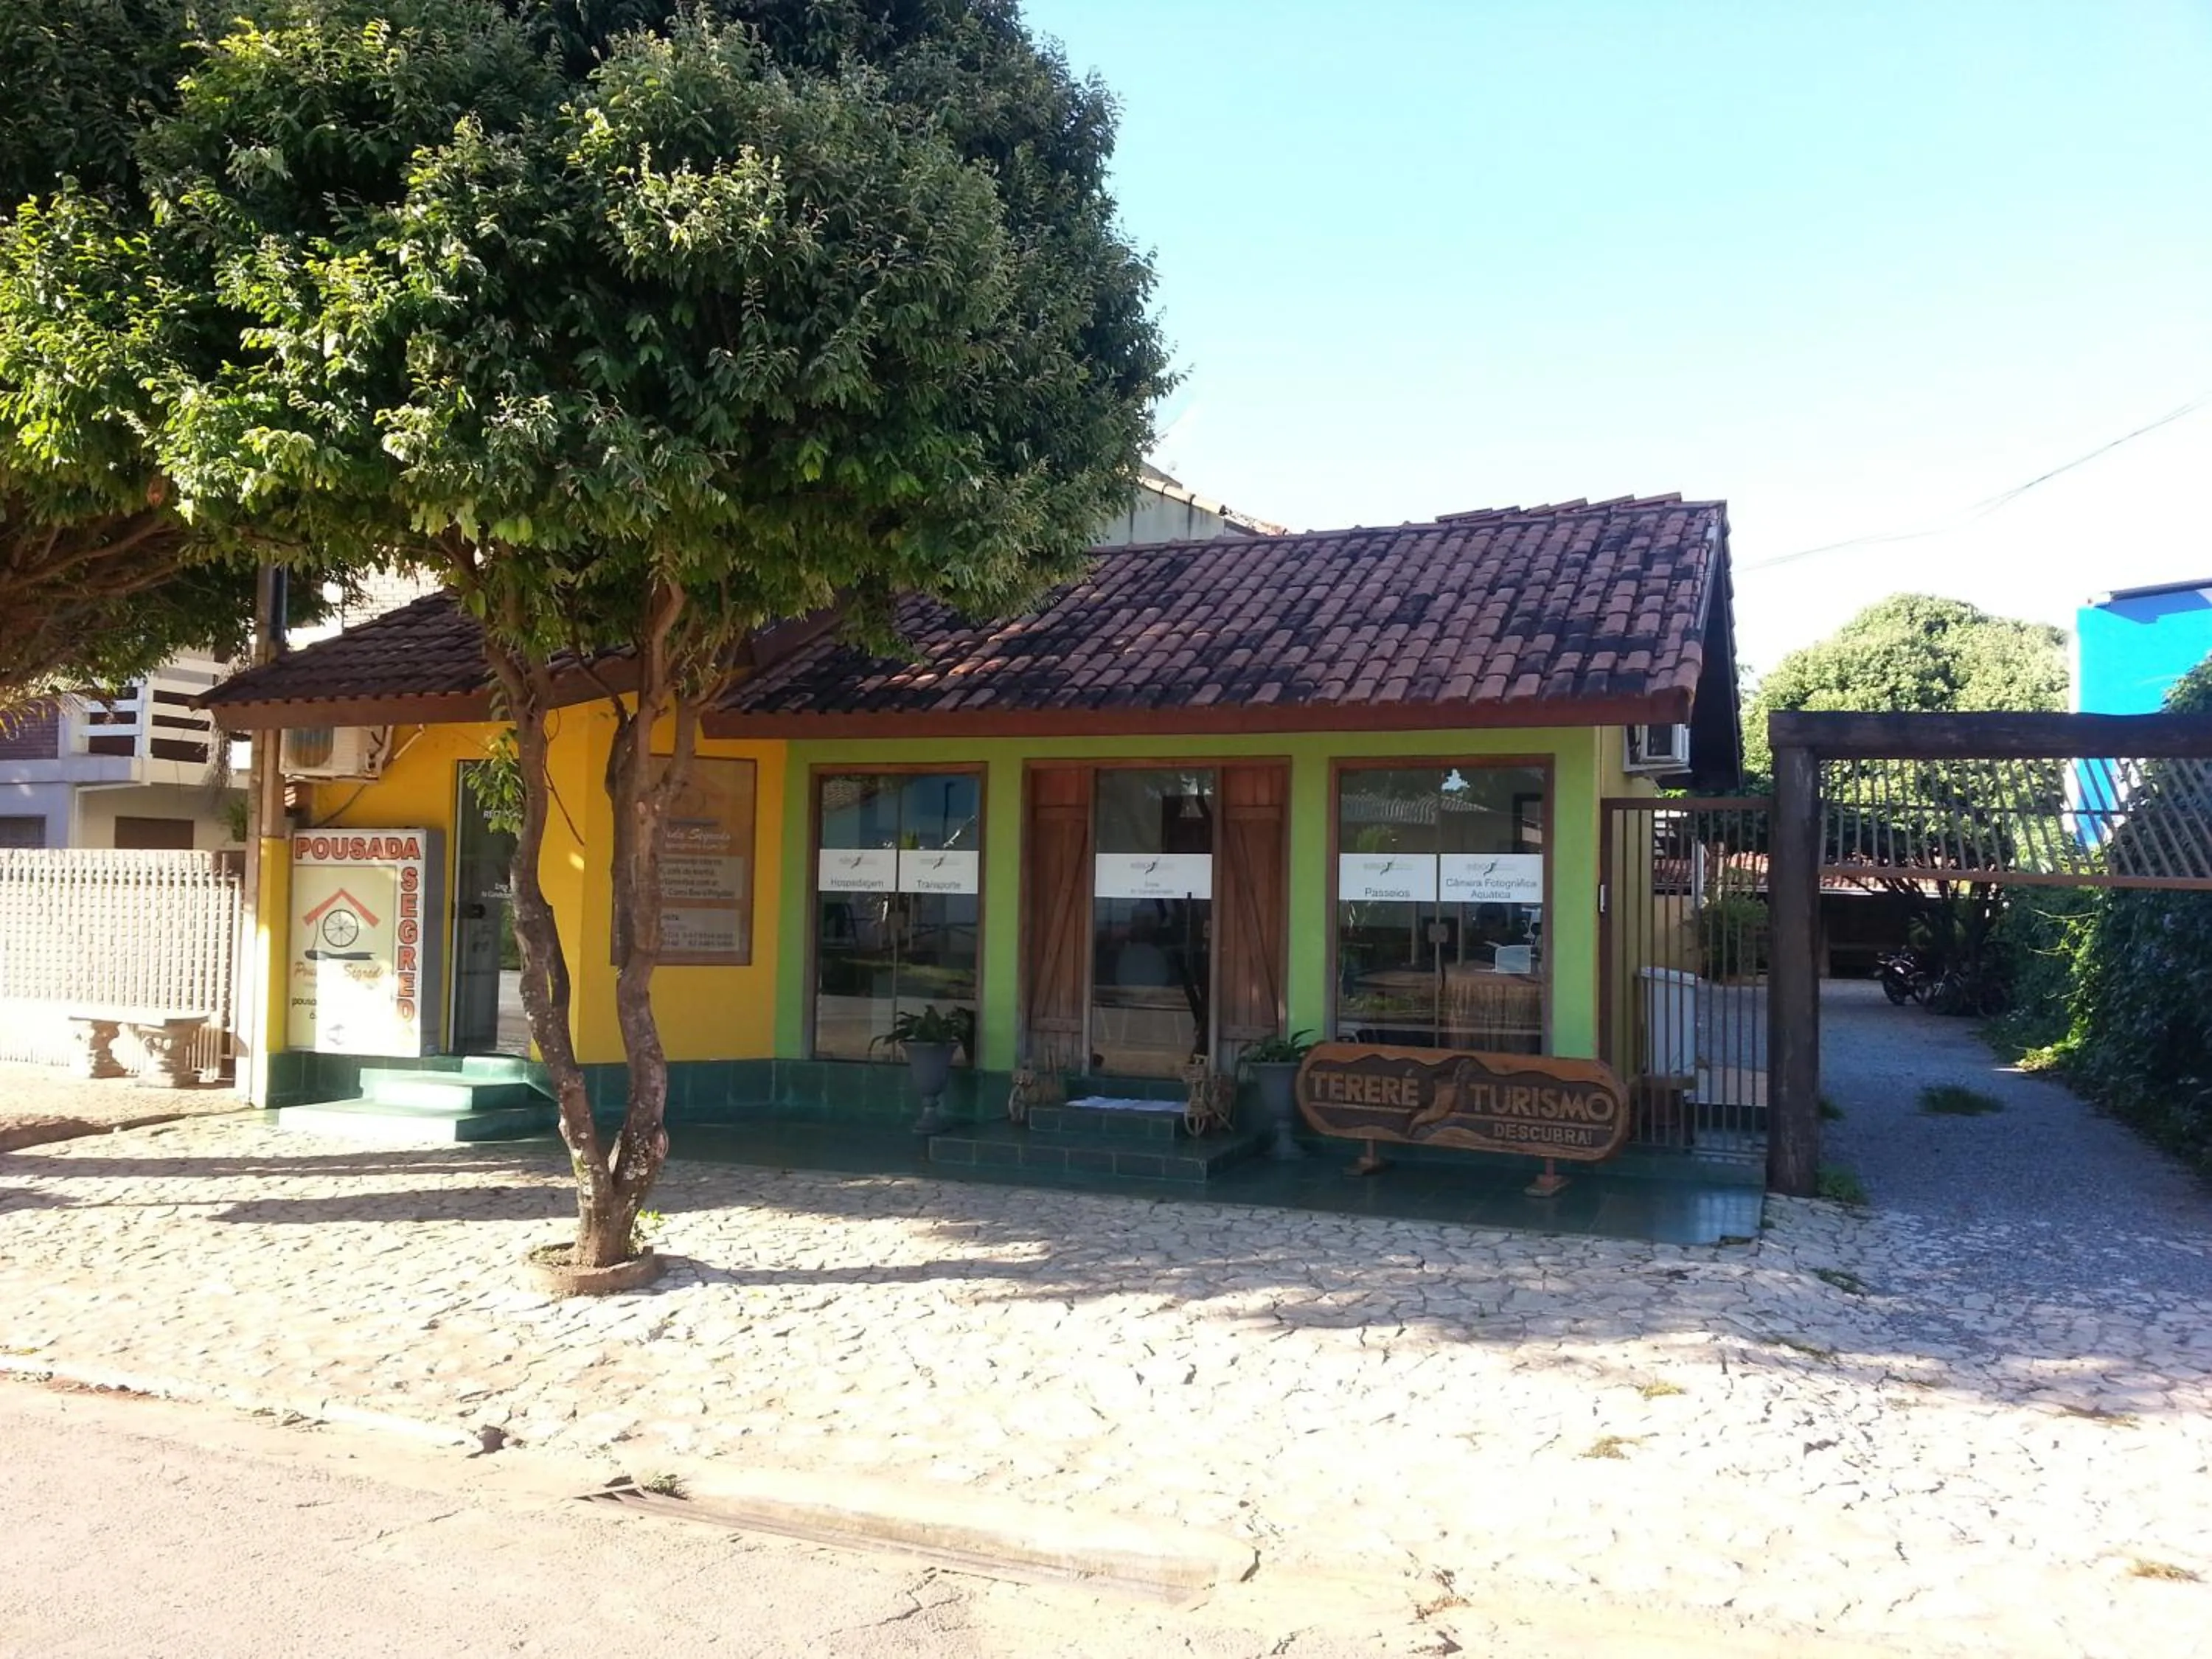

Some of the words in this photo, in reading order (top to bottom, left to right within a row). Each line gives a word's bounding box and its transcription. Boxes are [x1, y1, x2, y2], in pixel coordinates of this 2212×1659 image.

[295, 837, 422, 860] POUSADA
[830, 878, 884, 888] Hospedagem
[917, 879, 961, 889] Transporte
[1446, 877, 1482, 888] Câmera
[1485, 877, 1538, 890] Fotográfica
[1364, 887, 1411, 898] Passeios
[1470, 888, 1511, 899] Aquática
[397, 866, 419, 1036] SEGRED
[1310, 1068, 1419, 1107] TERERÉ
[1470, 1082, 1615, 1122] TURISMO
[1494, 1123, 1594, 1146] DESCUBRA!
